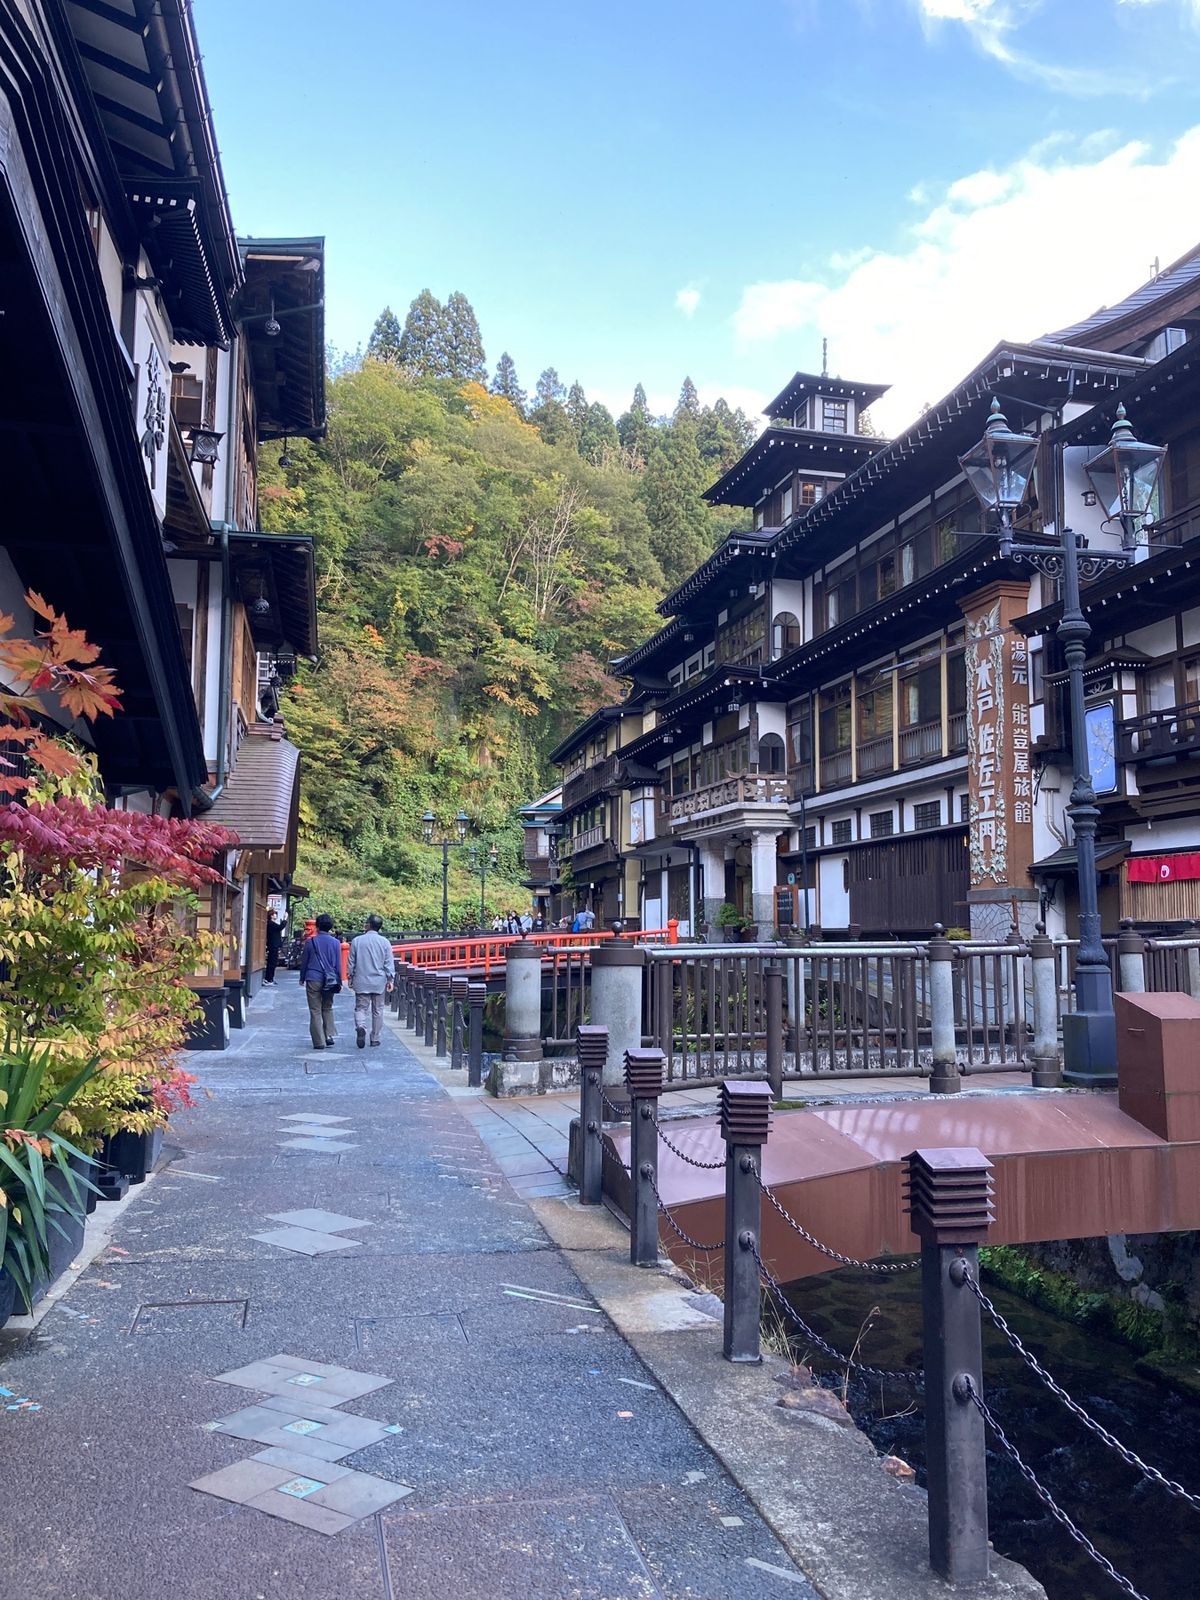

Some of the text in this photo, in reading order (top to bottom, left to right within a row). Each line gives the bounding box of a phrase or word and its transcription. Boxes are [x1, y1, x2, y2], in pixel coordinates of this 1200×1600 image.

[1010, 639, 1032, 825] 湯元 能登屋旅館
